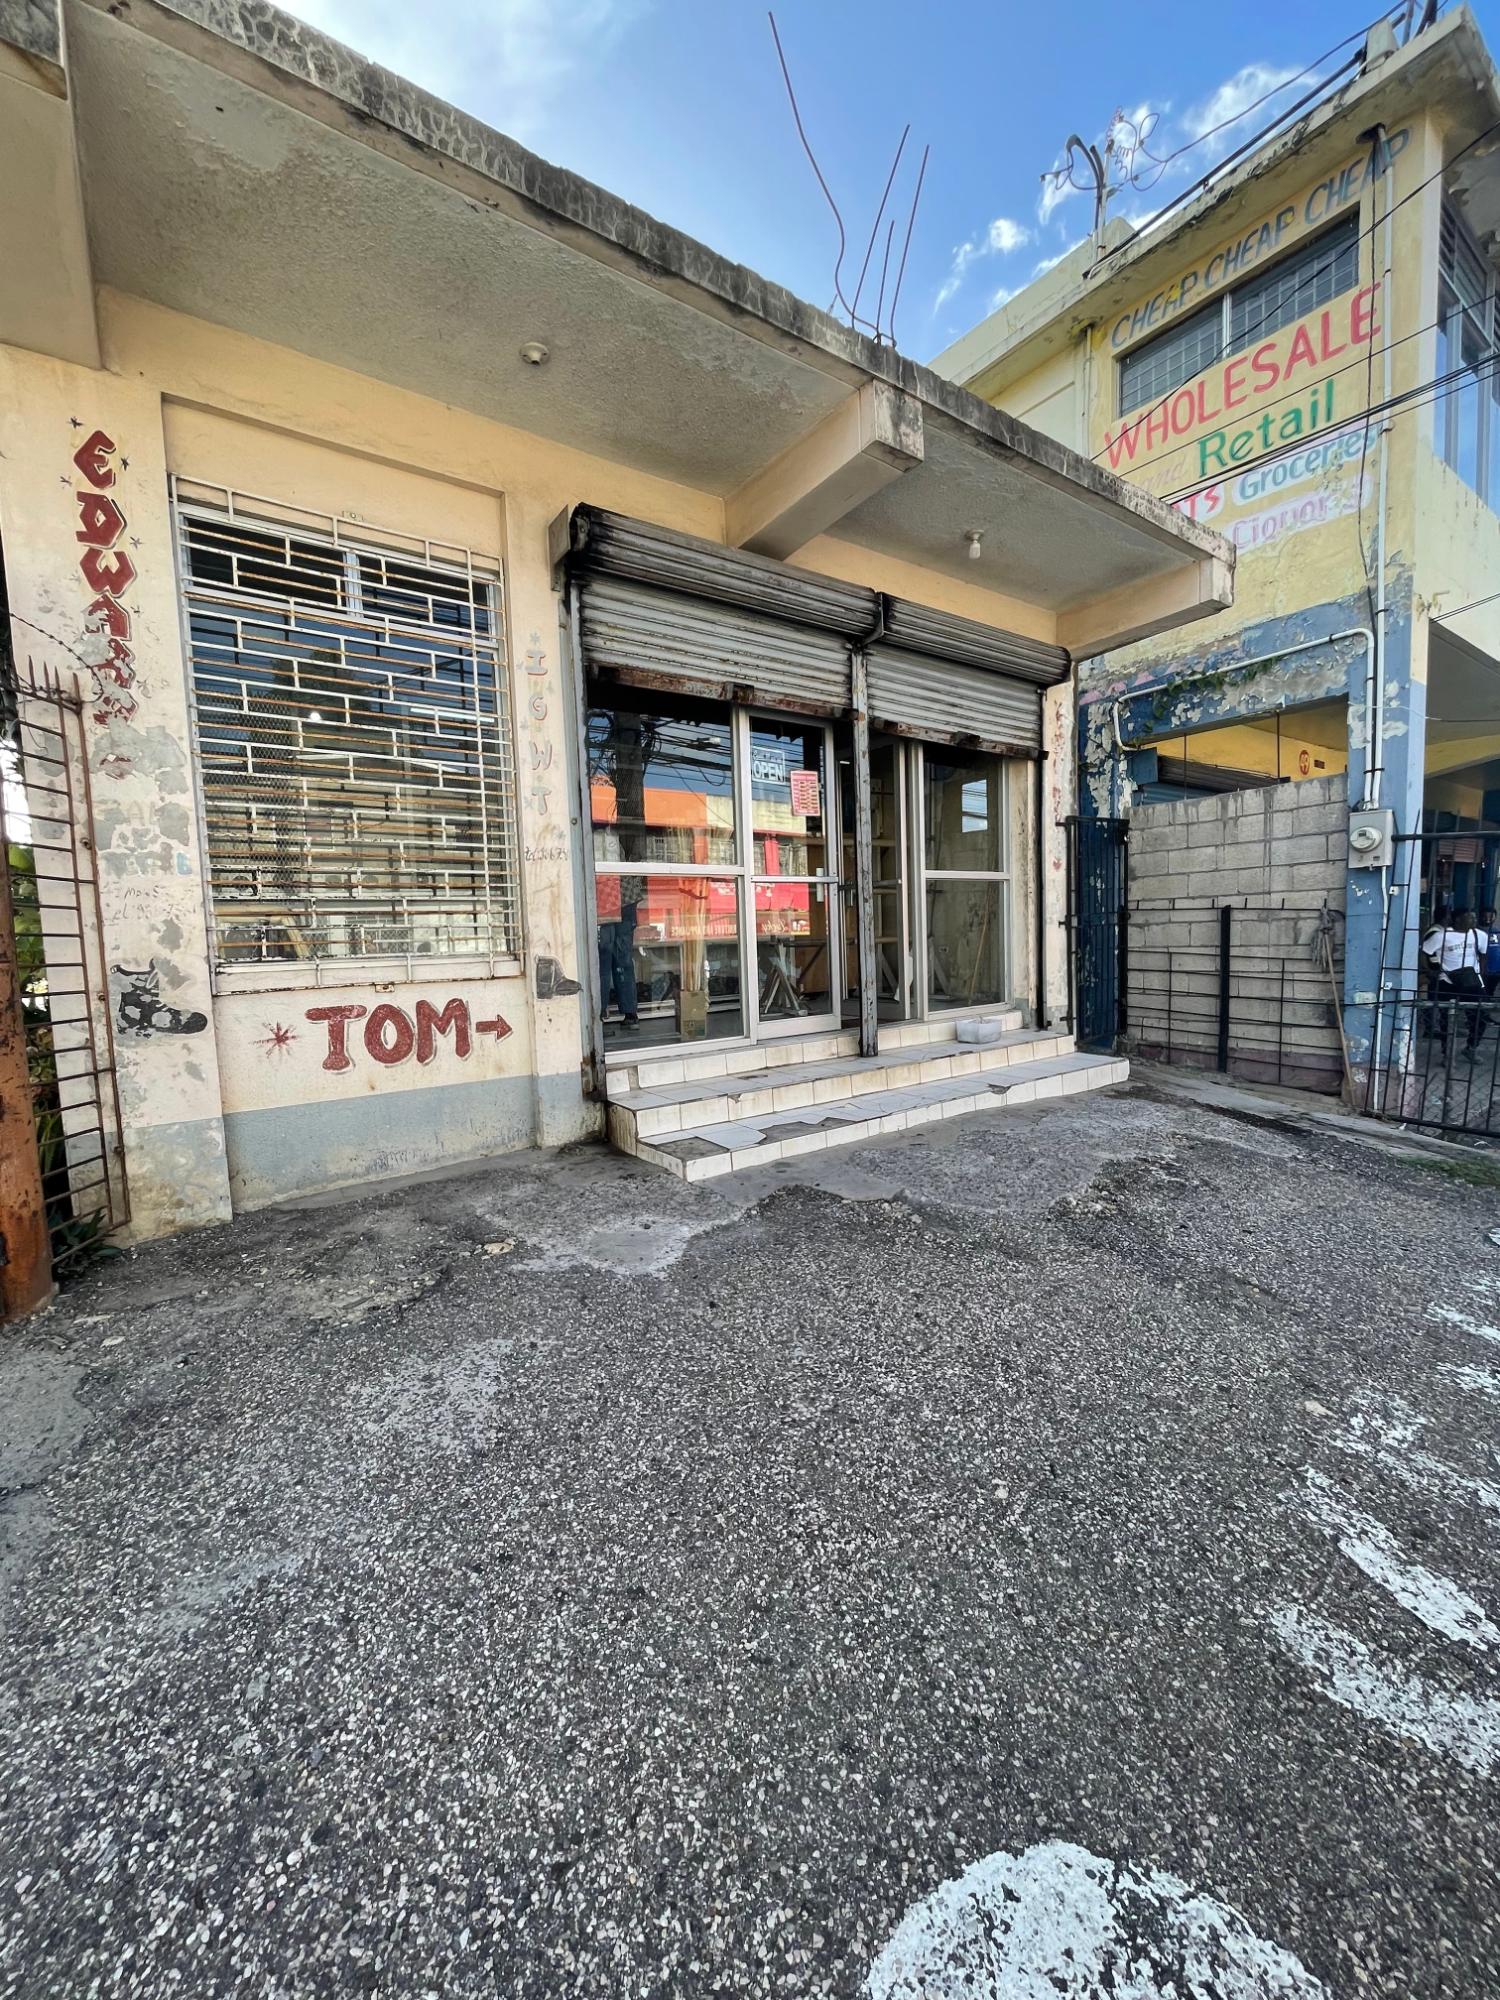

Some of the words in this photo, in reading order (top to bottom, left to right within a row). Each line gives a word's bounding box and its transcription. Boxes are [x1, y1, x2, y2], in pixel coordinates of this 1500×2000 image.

[1111, 271, 1198, 349] CHEAP
[1204, 206, 1295, 290] CHEAP
[1304, 129, 1410, 225] CHEAP
[1104, 282, 1382, 469] WHOLESALE
[1171, 485, 1221, 520] TS
[1238, 427, 1379, 501] Groceries
[1197, 378, 1334, 479] Retail
[753, 761, 784, 783] OPEN
[304, 998, 472, 1073] TOM
